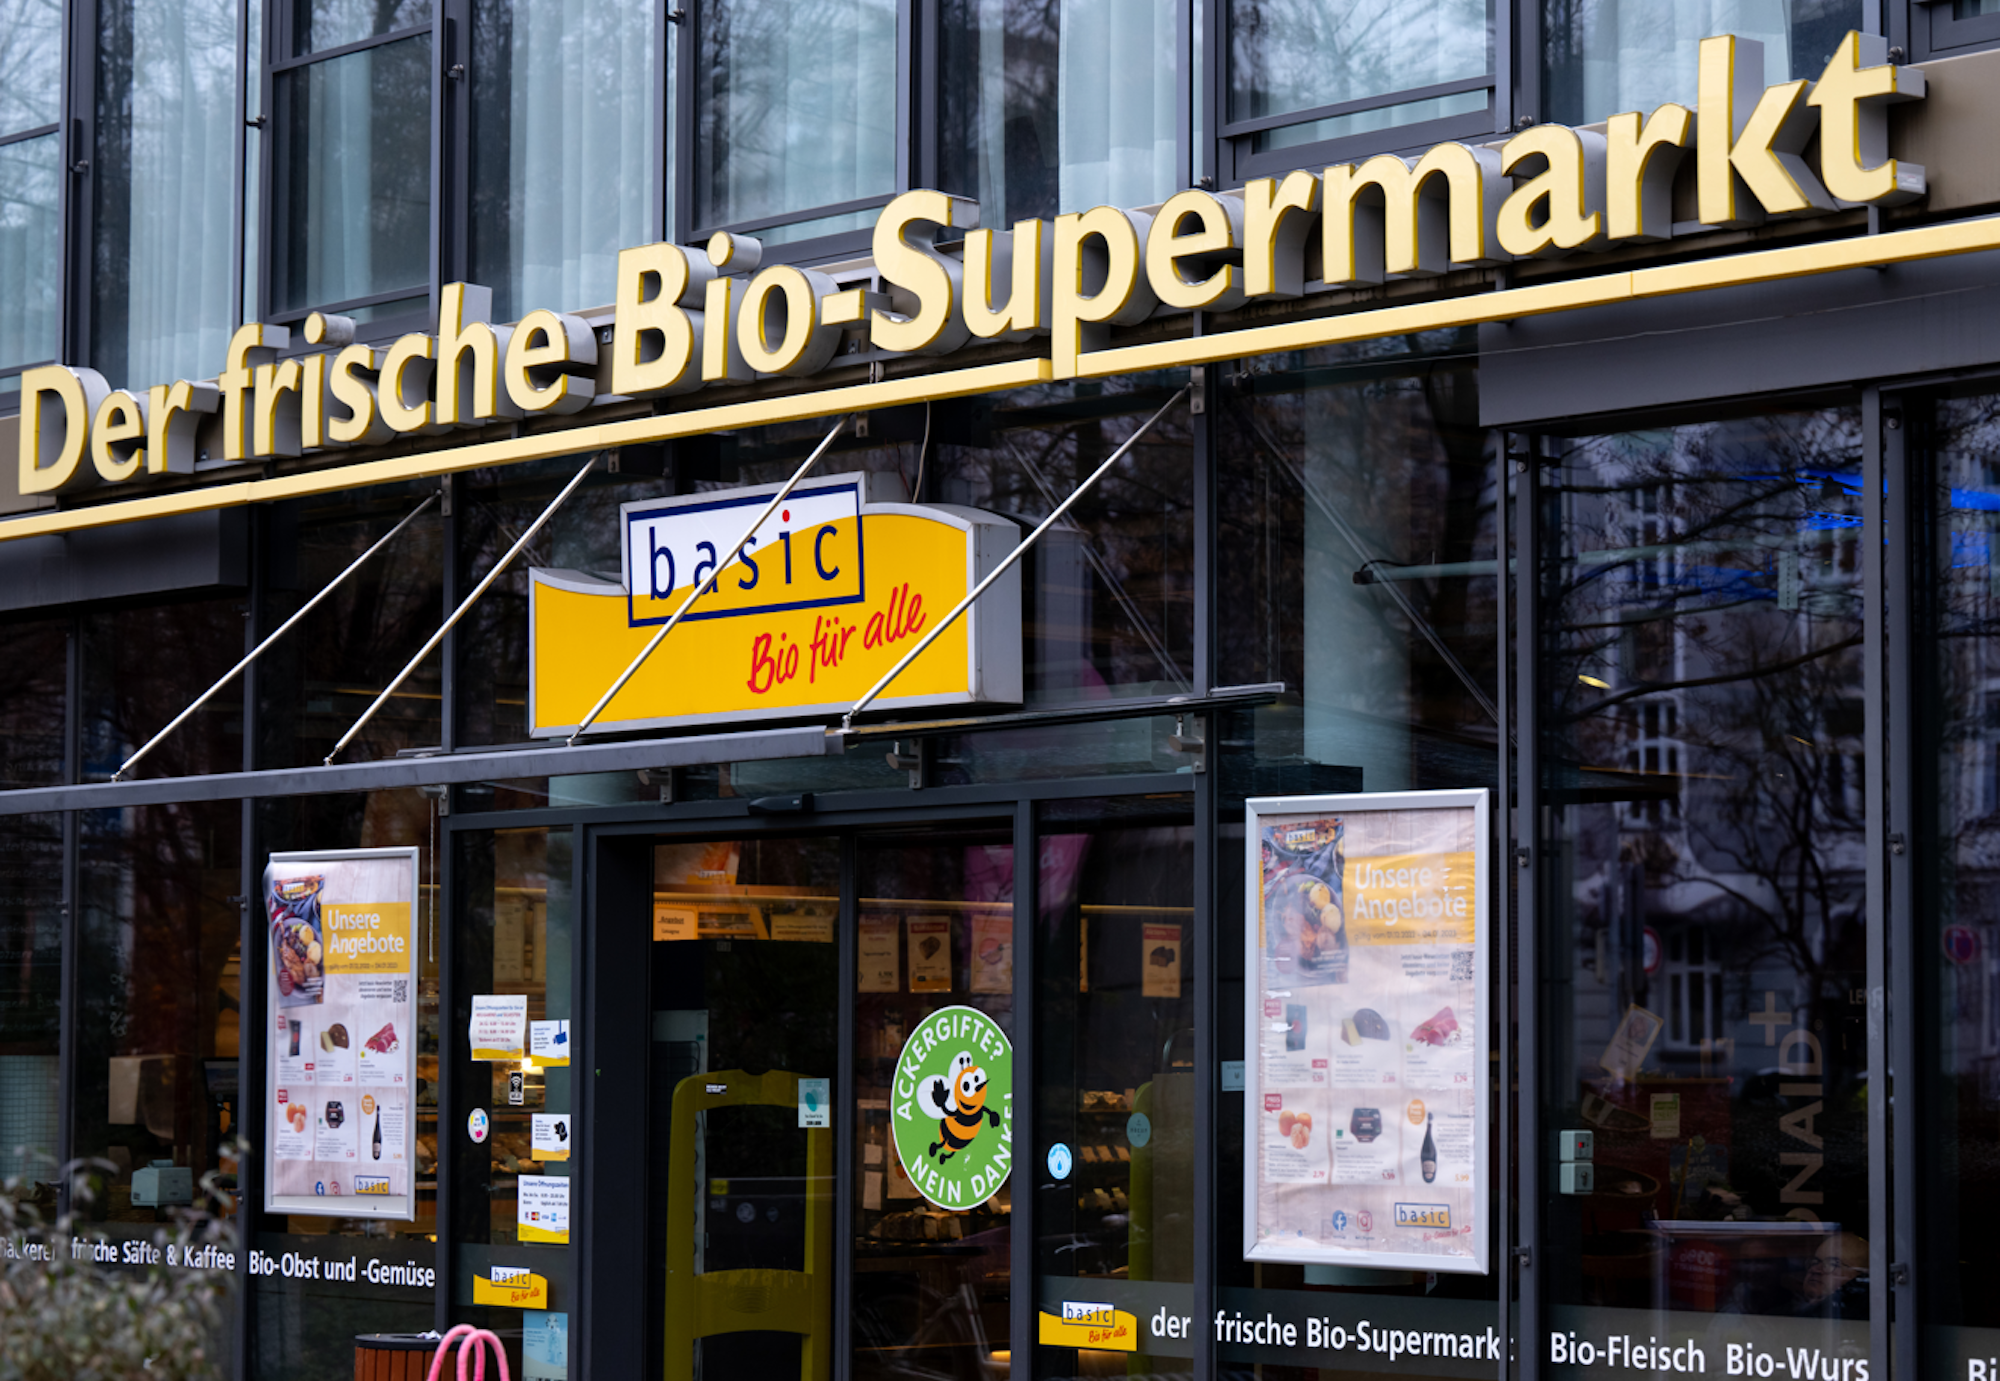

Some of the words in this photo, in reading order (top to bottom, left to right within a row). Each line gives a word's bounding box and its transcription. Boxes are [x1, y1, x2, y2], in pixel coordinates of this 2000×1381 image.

[18, 365, 198, 496] Der
[219, 282, 576, 461] frische
[612, 29, 1905, 397] Bio-Supermarkt
[649, 509, 841, 602] basic
[746, 630, 800, 695] Bio
[807, 613, 859, 683] für
[863, 582, 928, 651] alle
[1355, 863, 1433, 889] Unsere
[328, 909, 380, 930] Unsere
[1353, 891, 1467, 926] Angebote
[329, 931, 404, 960] Angebote
[897, 1014, 1004, 1121] ACKERGIFTE?
[359, 1178, 387, 1192] basic
[911, 1154, 962, 1203] NEIN
[1400, 1206, 1446, 1225] basic
[122, 1239, 161, 1265] Säfte
[166, 1244, 178, 1266] &
[183, 1244, 236, 1271] Kaffee
[248, 1250, 320, 1279] Bio-Obst
[324, 1256, 356, 1282] und
[361, 1258, 436, 1288] -Gemüse
[494, 1269, 527, 1285] basic
[1066, 1304, 1110, 1323] basic
[1150, 1306, 1192, 1339] der
[1214, 1310, 1298, 1347] frische
[1088, 1330, 1100, 1344] Bio
[1101, 1329, 1112, 1343] für
[1113, 1325, 1128, 1338] alle
[1550, 1331, 1706, 1374] Bio-Fleisch
[1726, 1342, 1870, 1381] Bio-Wurs
